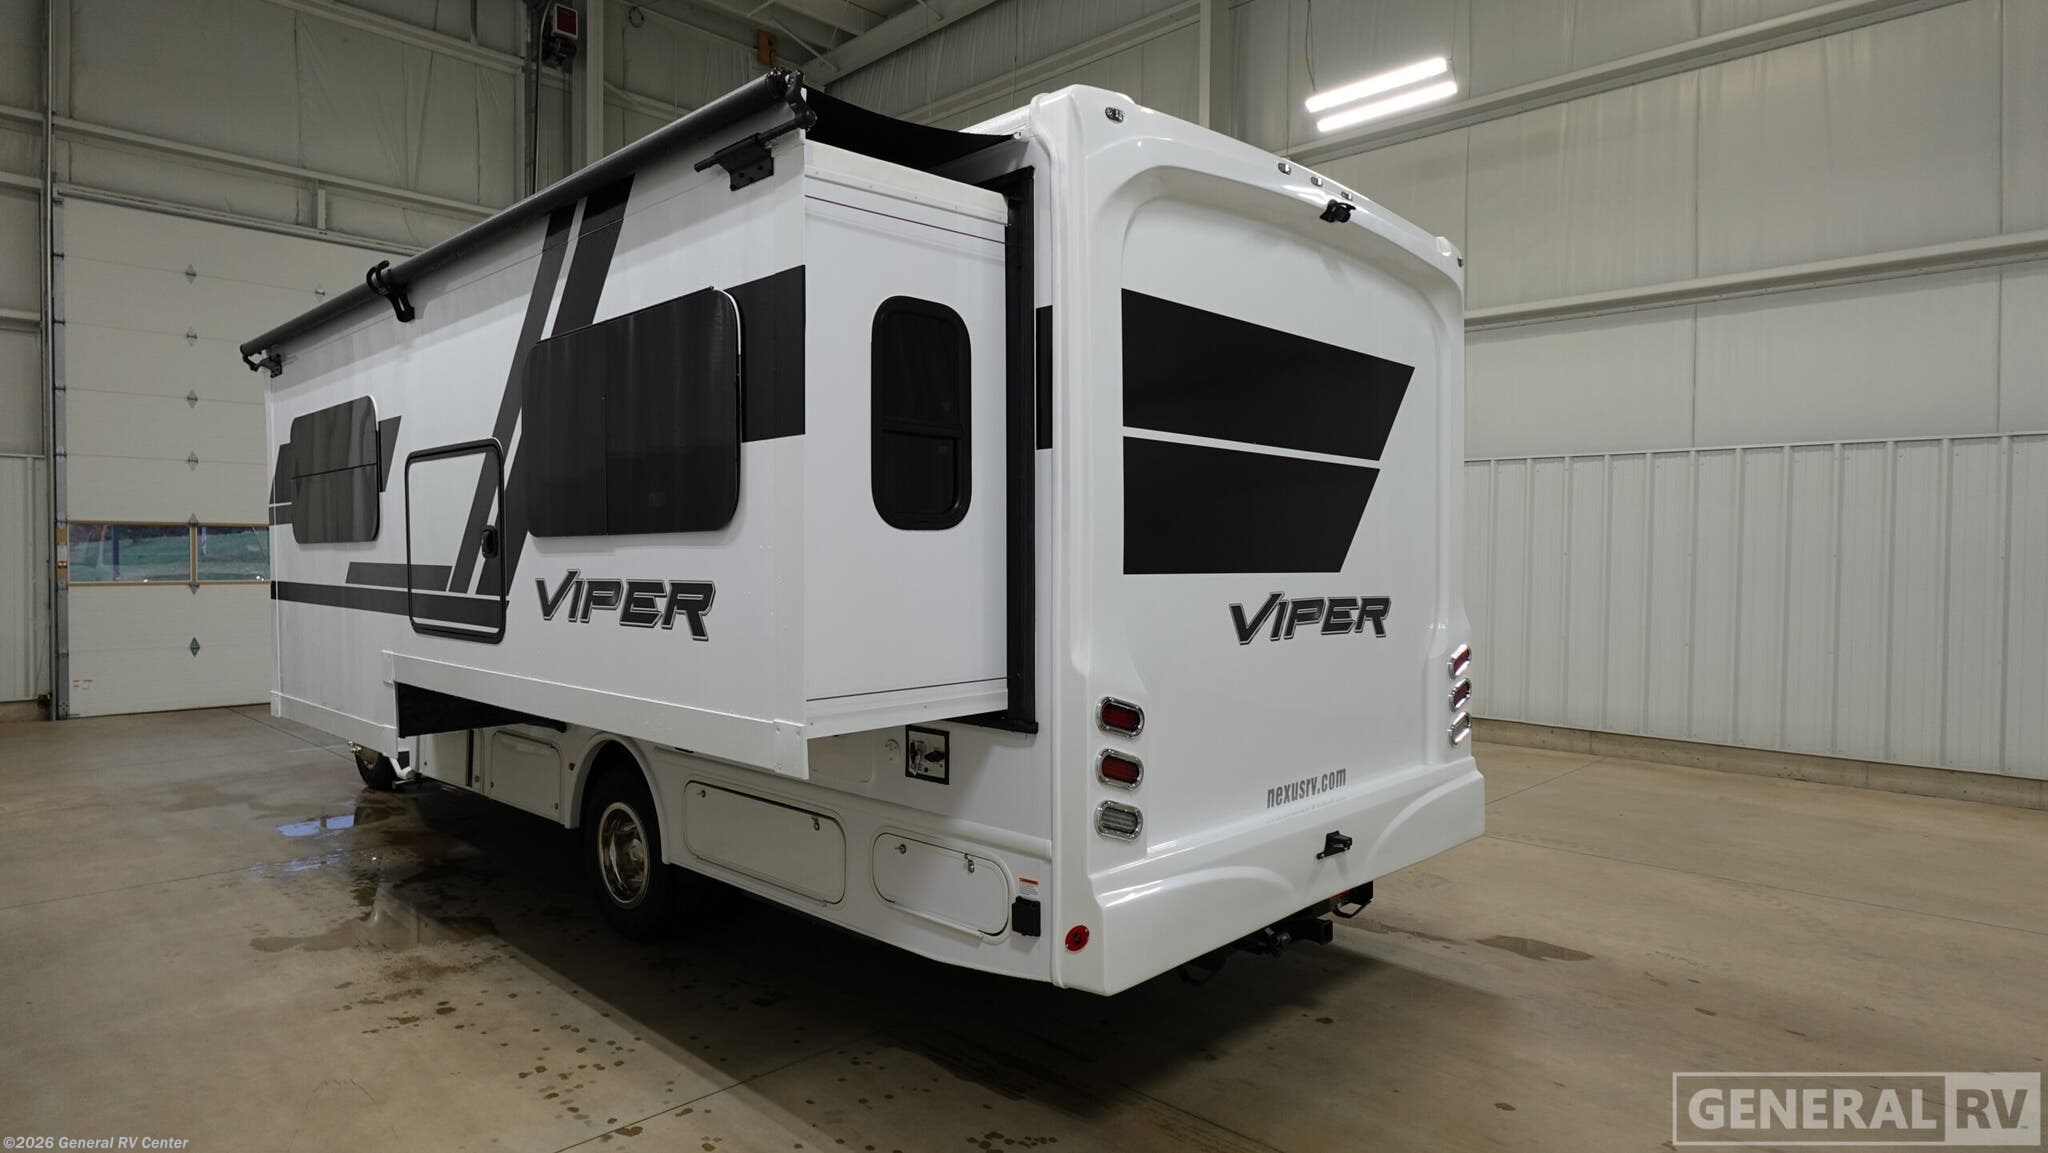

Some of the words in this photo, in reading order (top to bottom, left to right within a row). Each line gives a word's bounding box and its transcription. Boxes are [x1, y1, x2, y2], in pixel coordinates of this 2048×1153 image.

[535, 569, 716, 641] VIPER
[1229, 591, 1391, 645] VIPER
[1267, 767, 1346, 808] nexusrv.com
